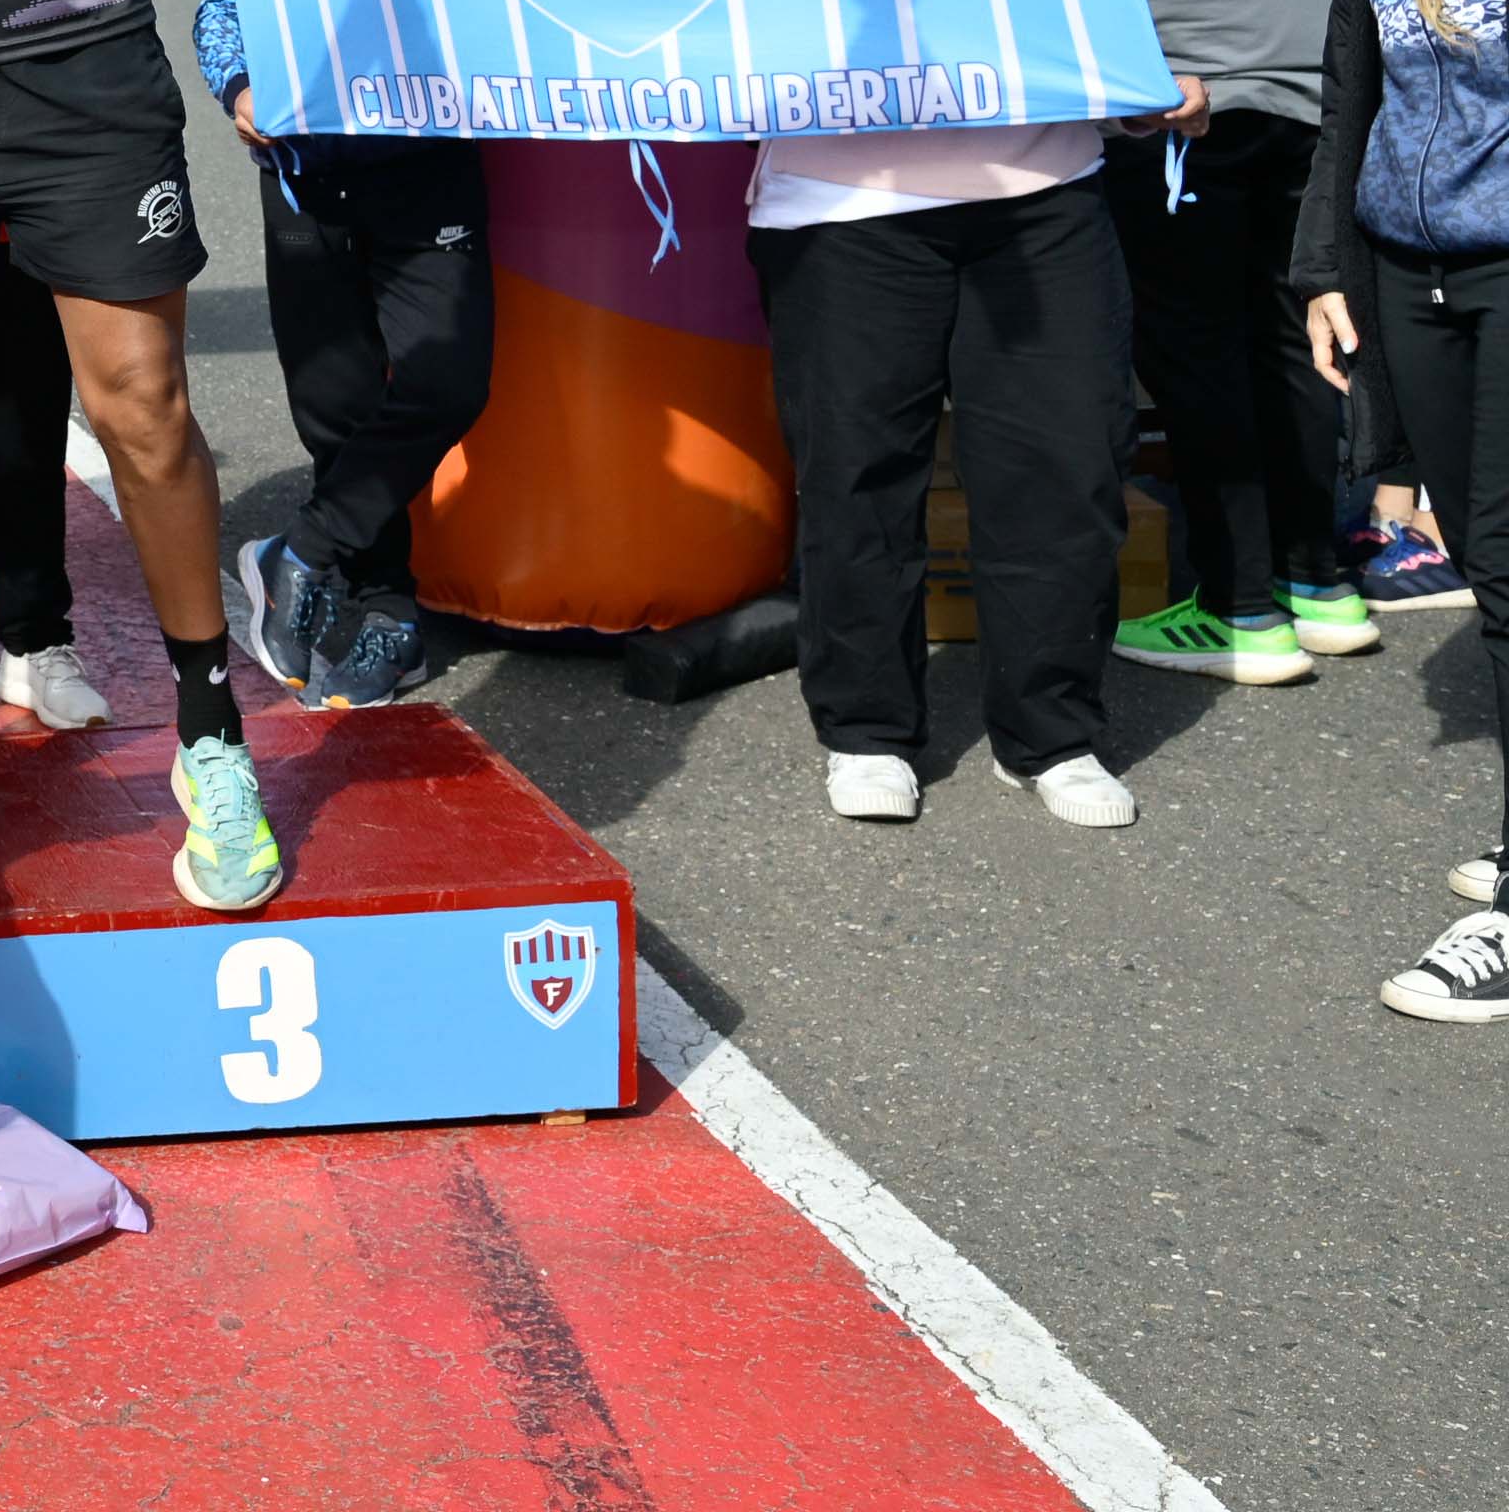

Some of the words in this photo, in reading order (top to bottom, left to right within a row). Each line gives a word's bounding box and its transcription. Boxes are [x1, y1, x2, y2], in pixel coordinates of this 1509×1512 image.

[350, 74, 461, 129] CLUB
[470, 74, 707, 132] ATLETICO
[713, 62, 1002, 133] LIBERTAD
[440, 225, 466, 237] NIKE
[215, 935, 322, 1105] 3
